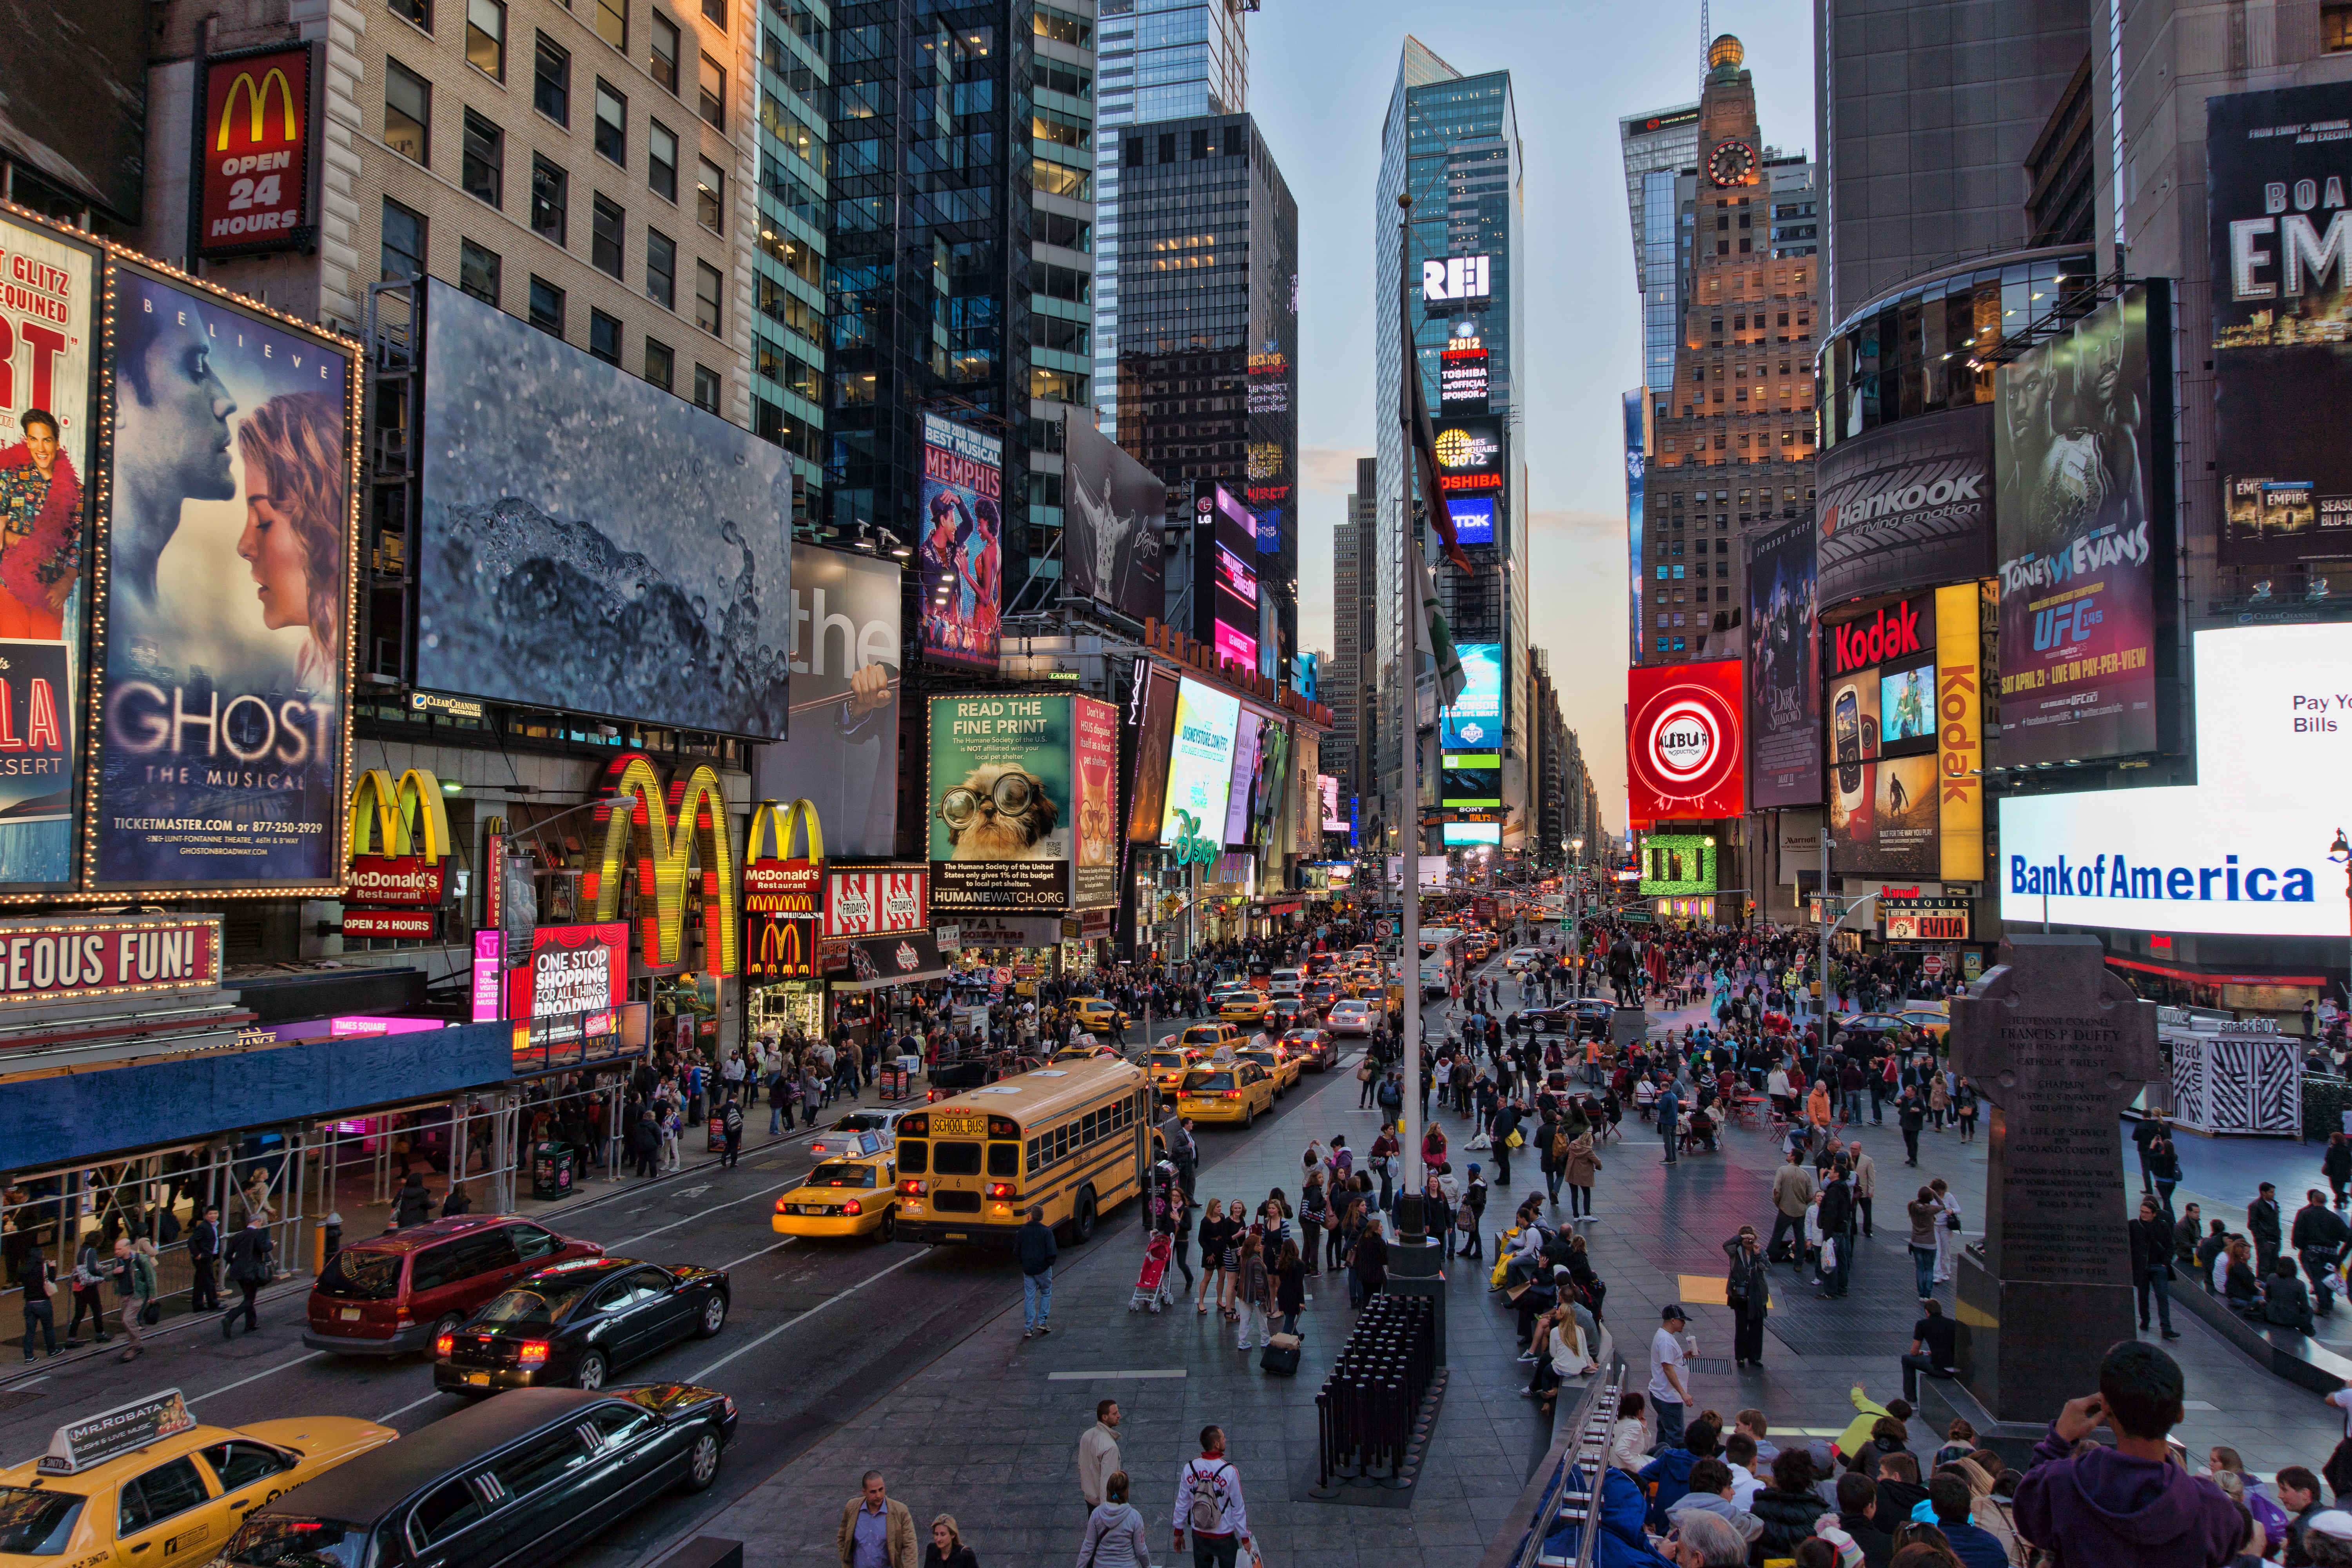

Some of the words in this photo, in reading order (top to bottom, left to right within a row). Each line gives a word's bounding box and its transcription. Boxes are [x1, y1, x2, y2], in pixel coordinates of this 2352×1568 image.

[222, 151, 290, 176] OPEN
[228, 174, 281, 211] 24
[212, 209, 297, 236] HOURS
[13, 255, 69, 297] GLITZ
[1424, 256, 1489, 301] REI
[143, 298, 328, 379] BELIEVE
[1449, 338, 1480, 351] 2012
[1441, 348, 1488, 360] TOSHIBA
[1442, 368, 1487, 379] TOSHIBA
[1451, 379, 1487, 389] OFFICIAL
[1442, 390, 1479, 400] SPONSOR
[926, 413, 951, 434] WINNER!
[951, 424, 966, 439] 2010
[967, 429, 981, 445] TONY
[982, 436, 1001, 453] AWARD
[926, 426, 953, 448] BEST
[956, 438, 1001, 466] MUSICAL
[1459, 438, 1485, 447] TIMES
[1464, 445, 1497, 454] SQUARE
[925, 446, 1000, 497] MEMPHIS
[960, 486, 976, 496] MUSICAL
[2267, 492, 2309, 506] EMPIRE
[1198, 514, 1212, 524] LG
[1452, 514, 1490, 528] TDK
[1853, 516, 1902, 536] driving
[1902, 503, 1982, 524] emotion
[1757, 533, 1788, 557] JOHNNY
[1790, 521, 1811, 539] DEPP
[2071, 520, 2151, 575] EVANS
[1223, 551, 1244, 577] BRILLIANCE
[2033, 597, 2094, 651] UFC
[2083, 610, 2103, 627] 145
[1229, 633, 1234, 646] LG
[1234, 636, 1248, 653] MARQUEE
[1836, 600, 1920, 673] Kodak
[2001, 676, 2014, 695] SAT
[2015, 670, 2037, 692] APRIL
[2037, 670, 2045, 687] 21
[2051, 664, 2068, 684] LIVE
[2069, 661, 2080, 681] ON
[2082, 647, 2147, 679] PAY-PER-VIEW
[1774, 686, 1797, 712] DARK
[448, 708, 481, 717] SPECTACOLOR
[957, 702, 1004, 717] READ
[1008, 701, 1042, 716] THE
[1770, 701, 1801, 731] SHADOWS
[107, 680, 338, 767] GHOST
[953, 720, 992, 735] FINE
[996, 719, 1047, 734] PRINT
[1080, 720, 1093, 733] HSUS
[1093, 724, 1111, 738] disguise
[2294, 717, 2338, 732] Bills
[991, 737, 1014, 745] Society
[1182, 725, 1228, 752] DISNEYSTORE.COM/FFC
[1941, 664, 1978, 805] Kodak
[1080, 737, 1091, 748] itself
[1091, 741, 1097, 750] as
[1101, 740, 1111, 753] local
[1083, 755, 1091, 767] pet
[1092, 756, 1108, 768] shelter.
[146, 766, 189, 784] THE
[206, 769, 305, 790] MUSICAL
[114, 818, 233, 832] TICKETMASTER.COM
[236, 823, 249, 832] or
[252, 821, 323, 834] 877-250-2929
[224, 836, 253, 844] THEATRE,
[2011, 855, 2074, 896] Bank
[2078, 854, 2105, 896] of
[2111, 855, 2315, 903] America
[356, 890, 421, 900] Restaurant
[935, 891, 1064, 904] HUMANEWATCH.ORG
[344, 920, 373, 930] OPEN
[376, 921, 390, 930] 24
[392, 920, 429, 931] HOURS
[1920, 917, 1964, 938] EVITA
[118, 931, 194, 984] FUN!
[537, 952, 569, 972] ONE
[572, 949, 607, 968] STOP
[536, 966, 608, 990] SHOPPING
[536, 989, 555, 1002] FOR
[557, 988, 573, 1001] ALL
[574, 982, 607, 997] THINGS
[534, 993, 609, 1020] BROADWAY
[335, 1021, 357, 1030] TIMES
[358, 1022, 387, 1031] SQUARE
[2001, 1028, 2056, 1040] FRANCIS
[2060, 1030, 2068, 1040] P
[2073, 1029, 2121, 1041] DUFFY
[2016, 1057, 2065, 1067] CATHOLIC
[2070, 1058, 2105, 1067] PRIEST
[2038, 1080, 2085, 1089] CHAPLAIN
[934, 1119, 966, 1132] SCHOOL
[967, 1120, 984, 1132] BUS
[2016, 1145, 2037, 1153] GOD
[2065, 1146, 2111, 1155] COUNTRY
[956, 1178, 960, 1188] 6
[73, 1439, 100, 1454] SUSHI
[107, 1432, 127, 1442] LIVE
[127, 1422, 153, 1435] MUSIC
